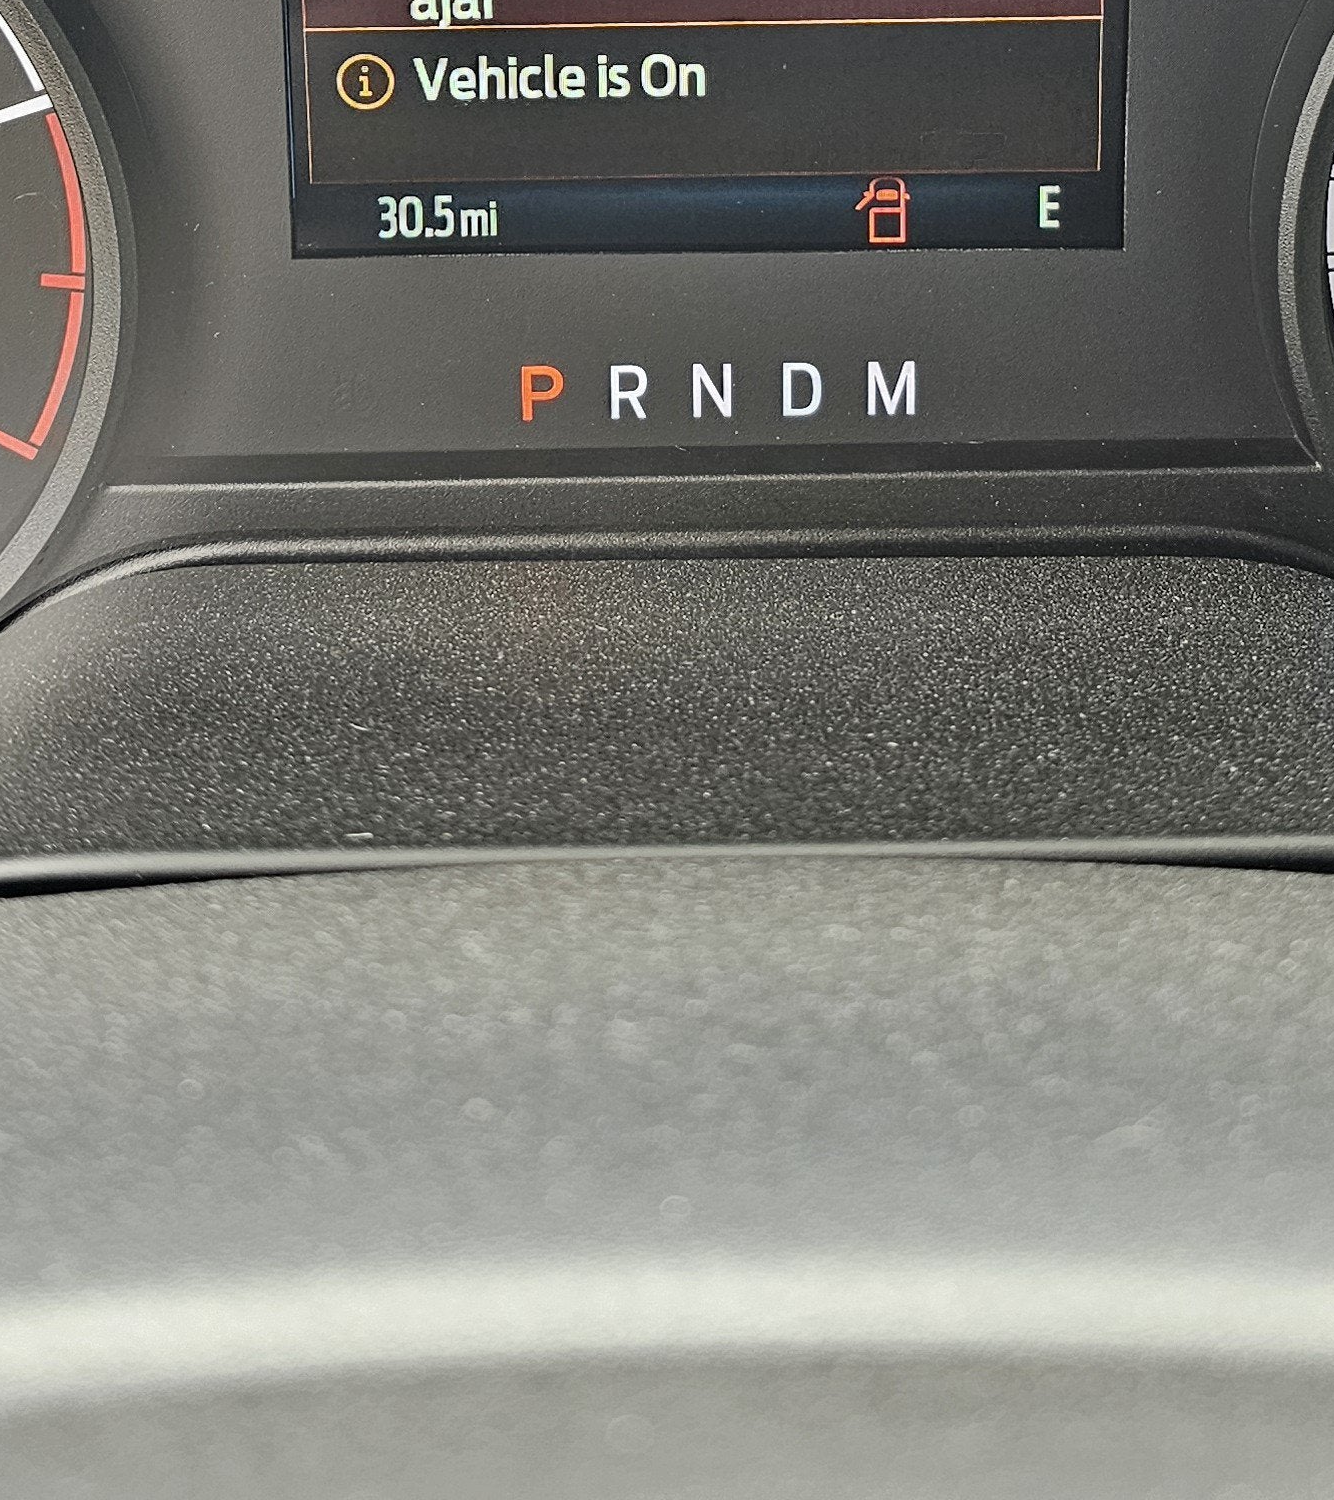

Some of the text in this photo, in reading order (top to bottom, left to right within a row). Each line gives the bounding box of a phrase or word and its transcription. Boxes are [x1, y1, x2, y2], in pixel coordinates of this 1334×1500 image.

[412, 53, 706, 101] Vehicle is On
[377, 194, 498, 239] 30.5 mi
[1039, 185, 1061, 228] E
[521, 360, 916, 422] P R N D M
